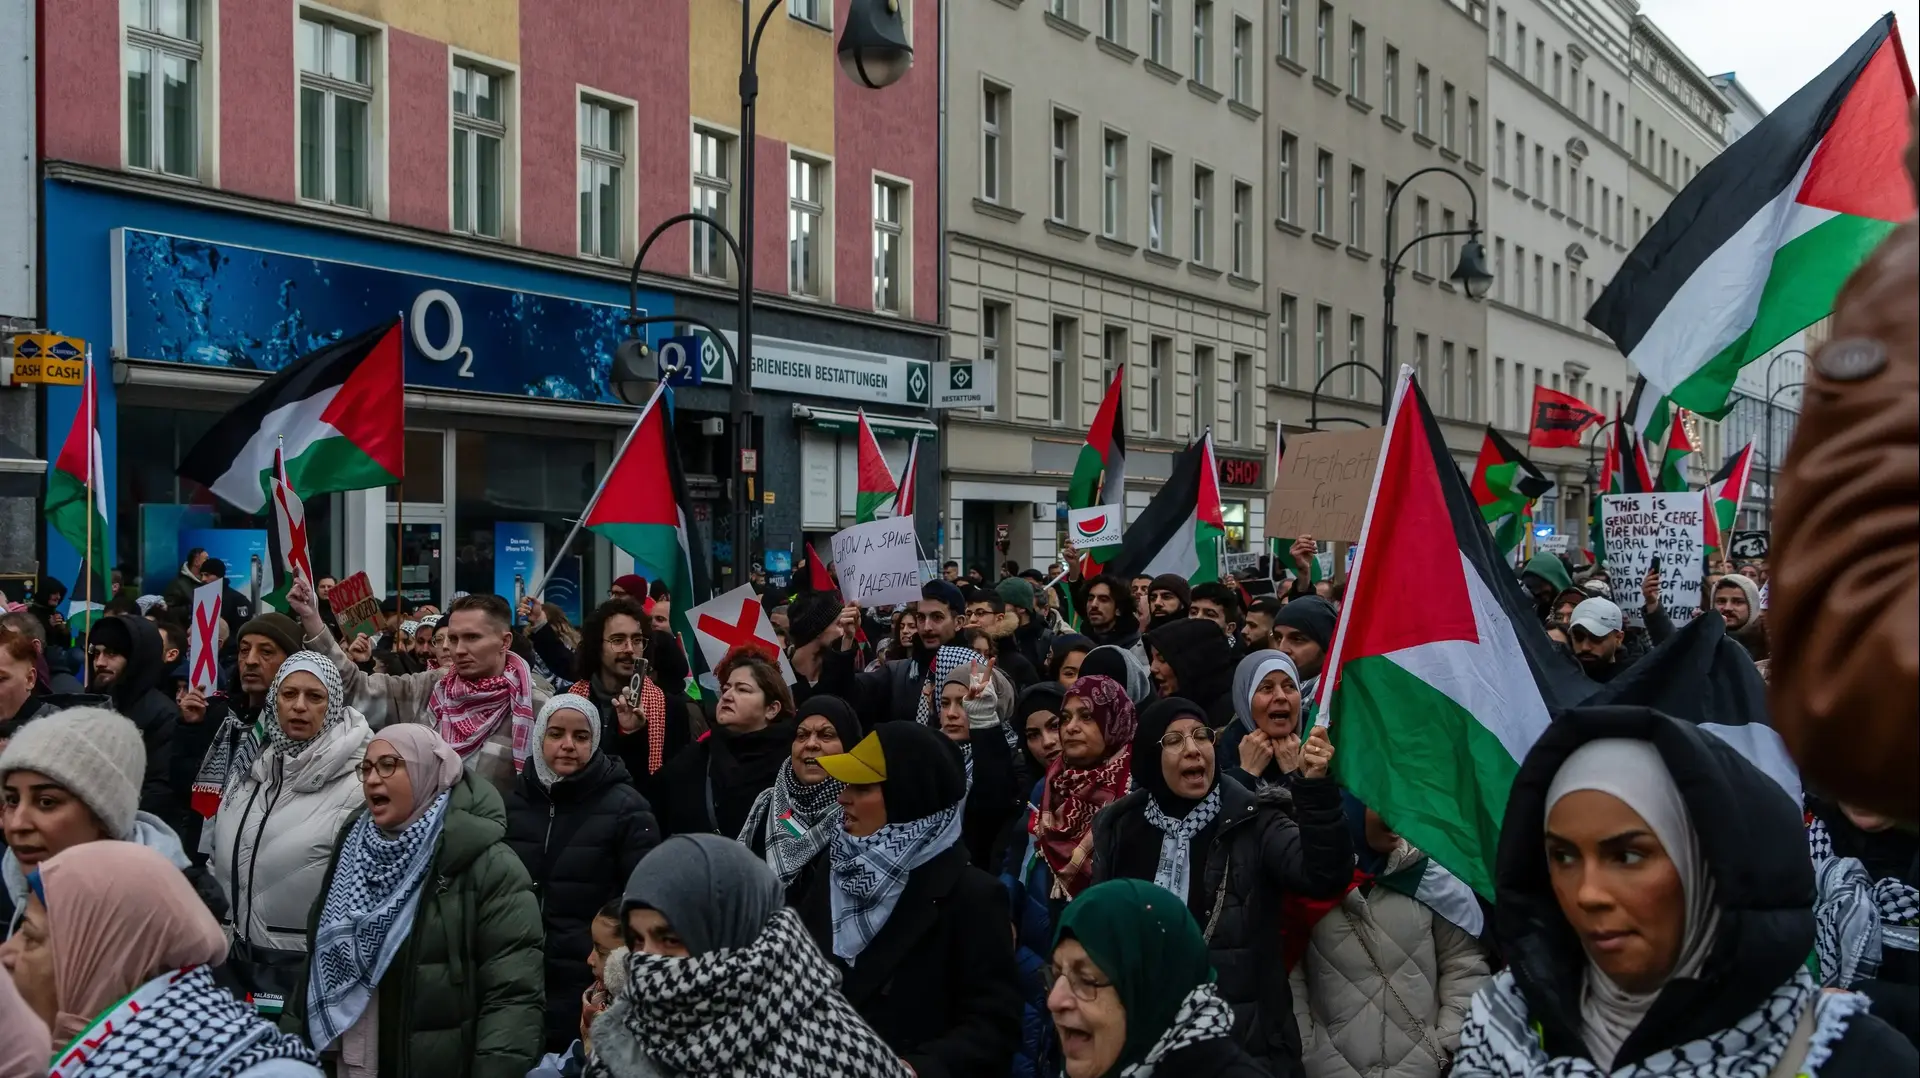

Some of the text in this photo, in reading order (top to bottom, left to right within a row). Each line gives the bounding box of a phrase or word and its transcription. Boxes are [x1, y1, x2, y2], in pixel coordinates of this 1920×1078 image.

[15, 364, 41, 377] CASH
[46, 365, 81, 380] CASH
[751, 356, 888, 389] GRIENEISEN BESTATTUNGEN
[941, 395, 981, 403] BESTATTUNG
[1291, 440, 1376, 482] Freiheit
[1226, 460, 1260, 484] SHOP
[1312, 481, 1343, 509] für
[1664, 511, 1702, 526] CEASE-
[1605, 525, 1630, 538] FIRE
[1680, 528, 1689, 537] A
[864, 537, 874, 554] A
[877, 531, 912, 548] SPINE
[1606, 539, 1702, 552] MORAL IMPER-
[1638, 552, 1648, 564] 4
[843, 565, 856, 583] FOR
[1610, 566, 1683, 580] ONE WH A
[858, 571, 918, 598] PALESTINE
[1612, 578, 1642, 590] SPAR
[1661, 580, 1676, 590] OF
[1666, 605, 1695, 620] HEAR
